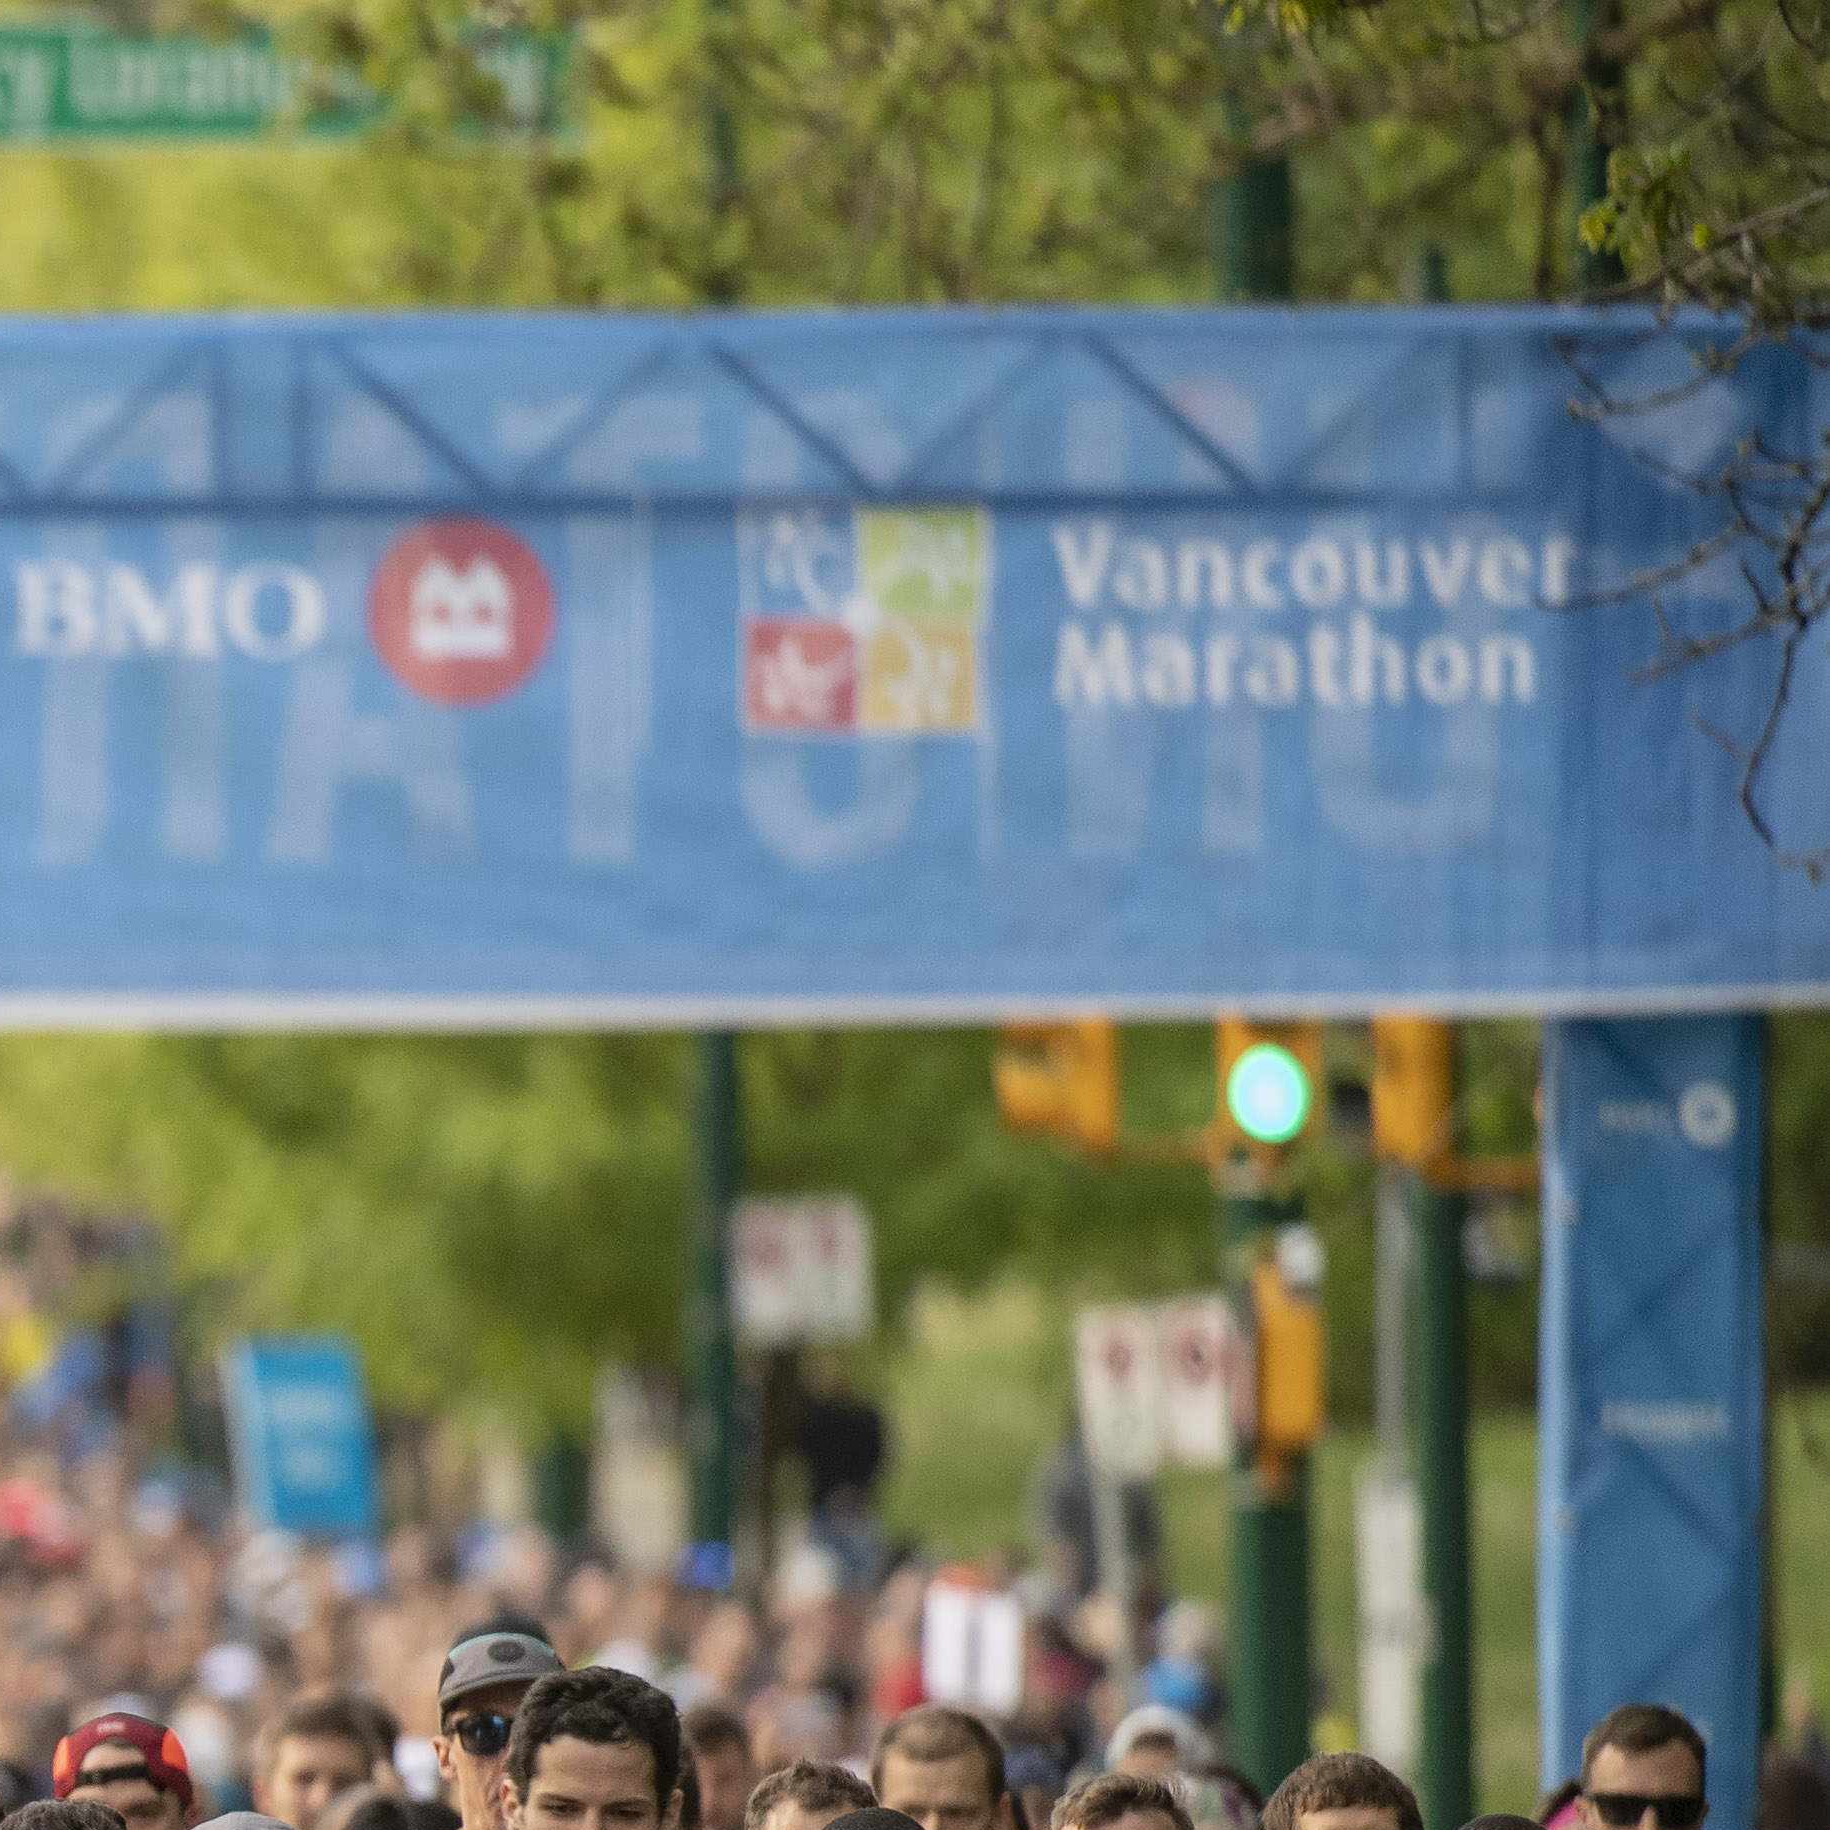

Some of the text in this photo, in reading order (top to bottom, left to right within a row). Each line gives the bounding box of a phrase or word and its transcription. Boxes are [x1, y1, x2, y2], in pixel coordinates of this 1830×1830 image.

[13, 560, 325, 662] BMO
[1053, 523, 1577, 607] Vancouver
[1055, 614, 1535, 708] Marathon
